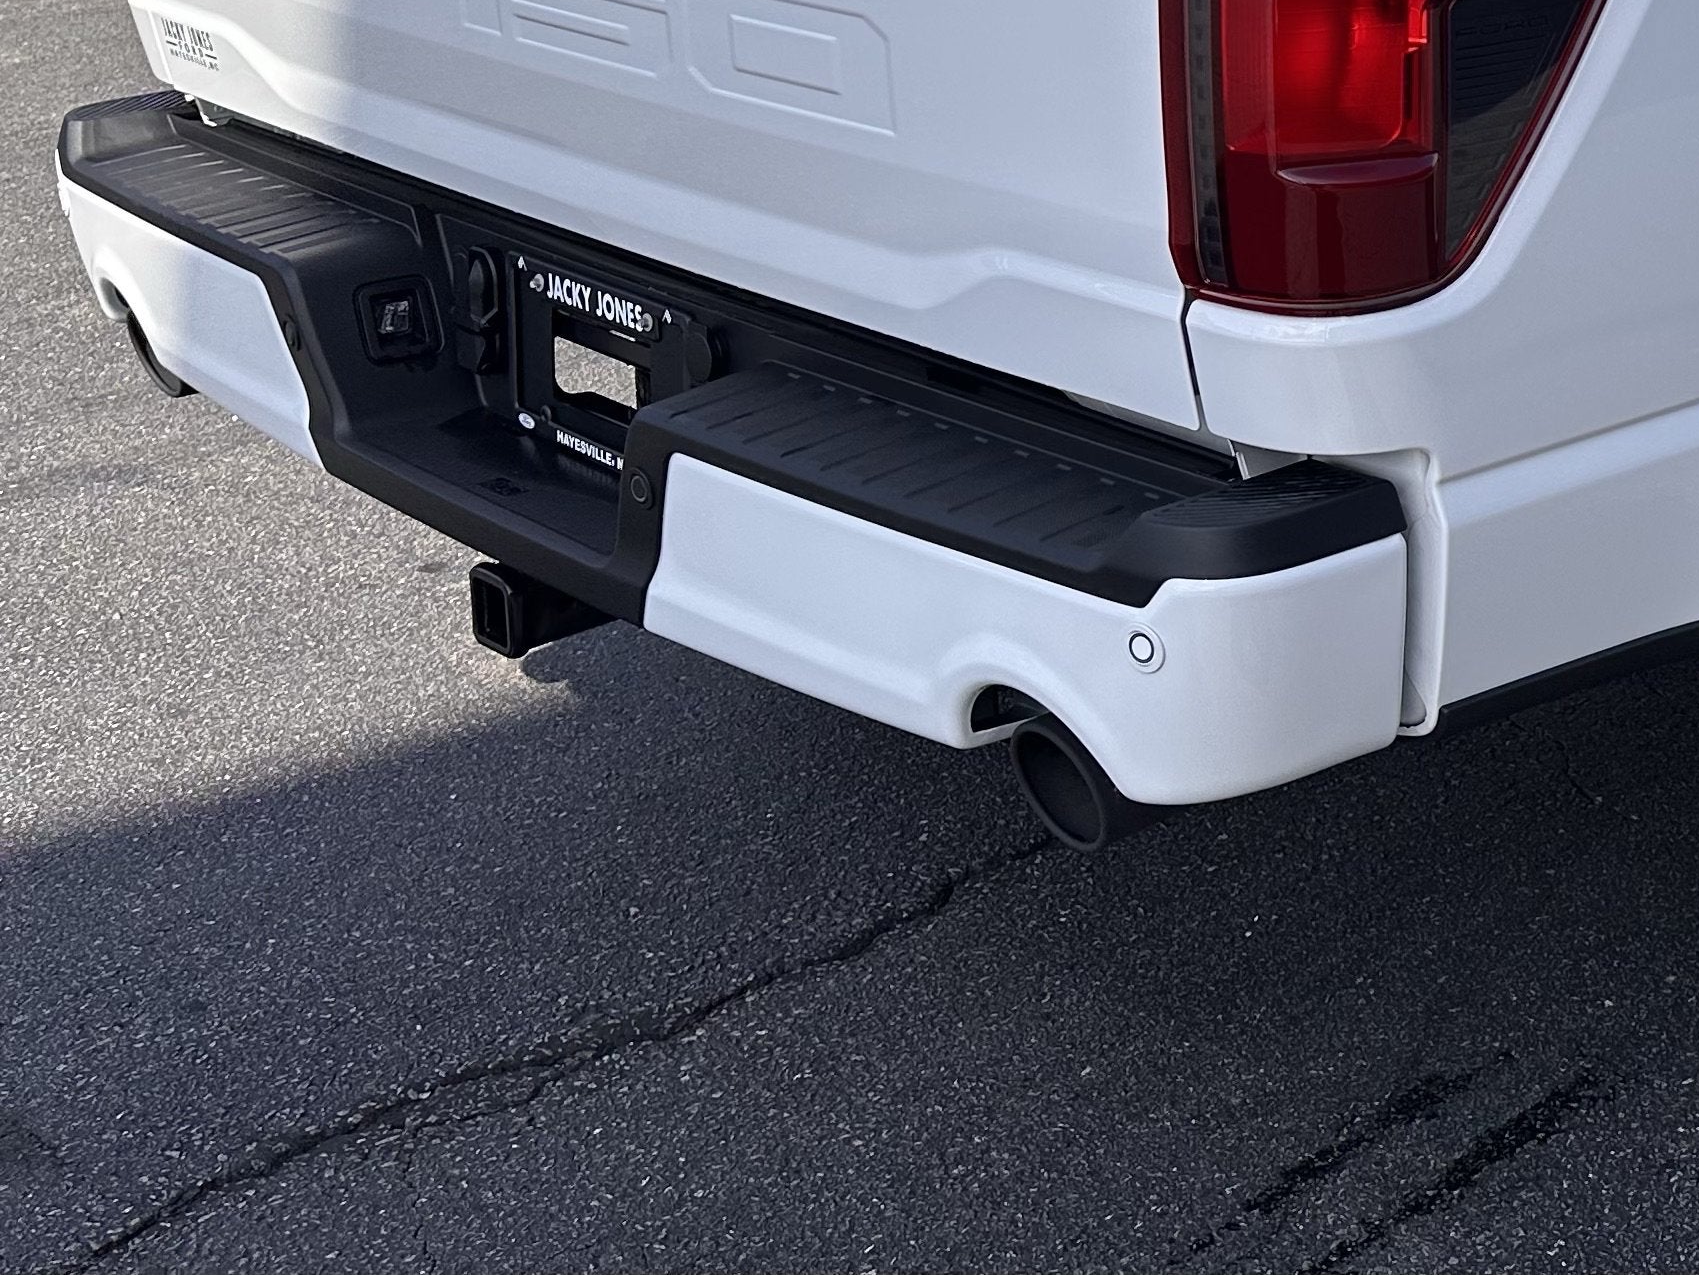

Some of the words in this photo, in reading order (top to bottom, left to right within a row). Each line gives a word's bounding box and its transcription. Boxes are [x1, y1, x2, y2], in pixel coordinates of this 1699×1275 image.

[161, 17, 186, 42] JACKY
[187, 26, 213, 51] JONES
[178, 40, 204, 58] FORD
[547, 272, 592, 312] JACKY
[595, 290, 644, 333] JONES
